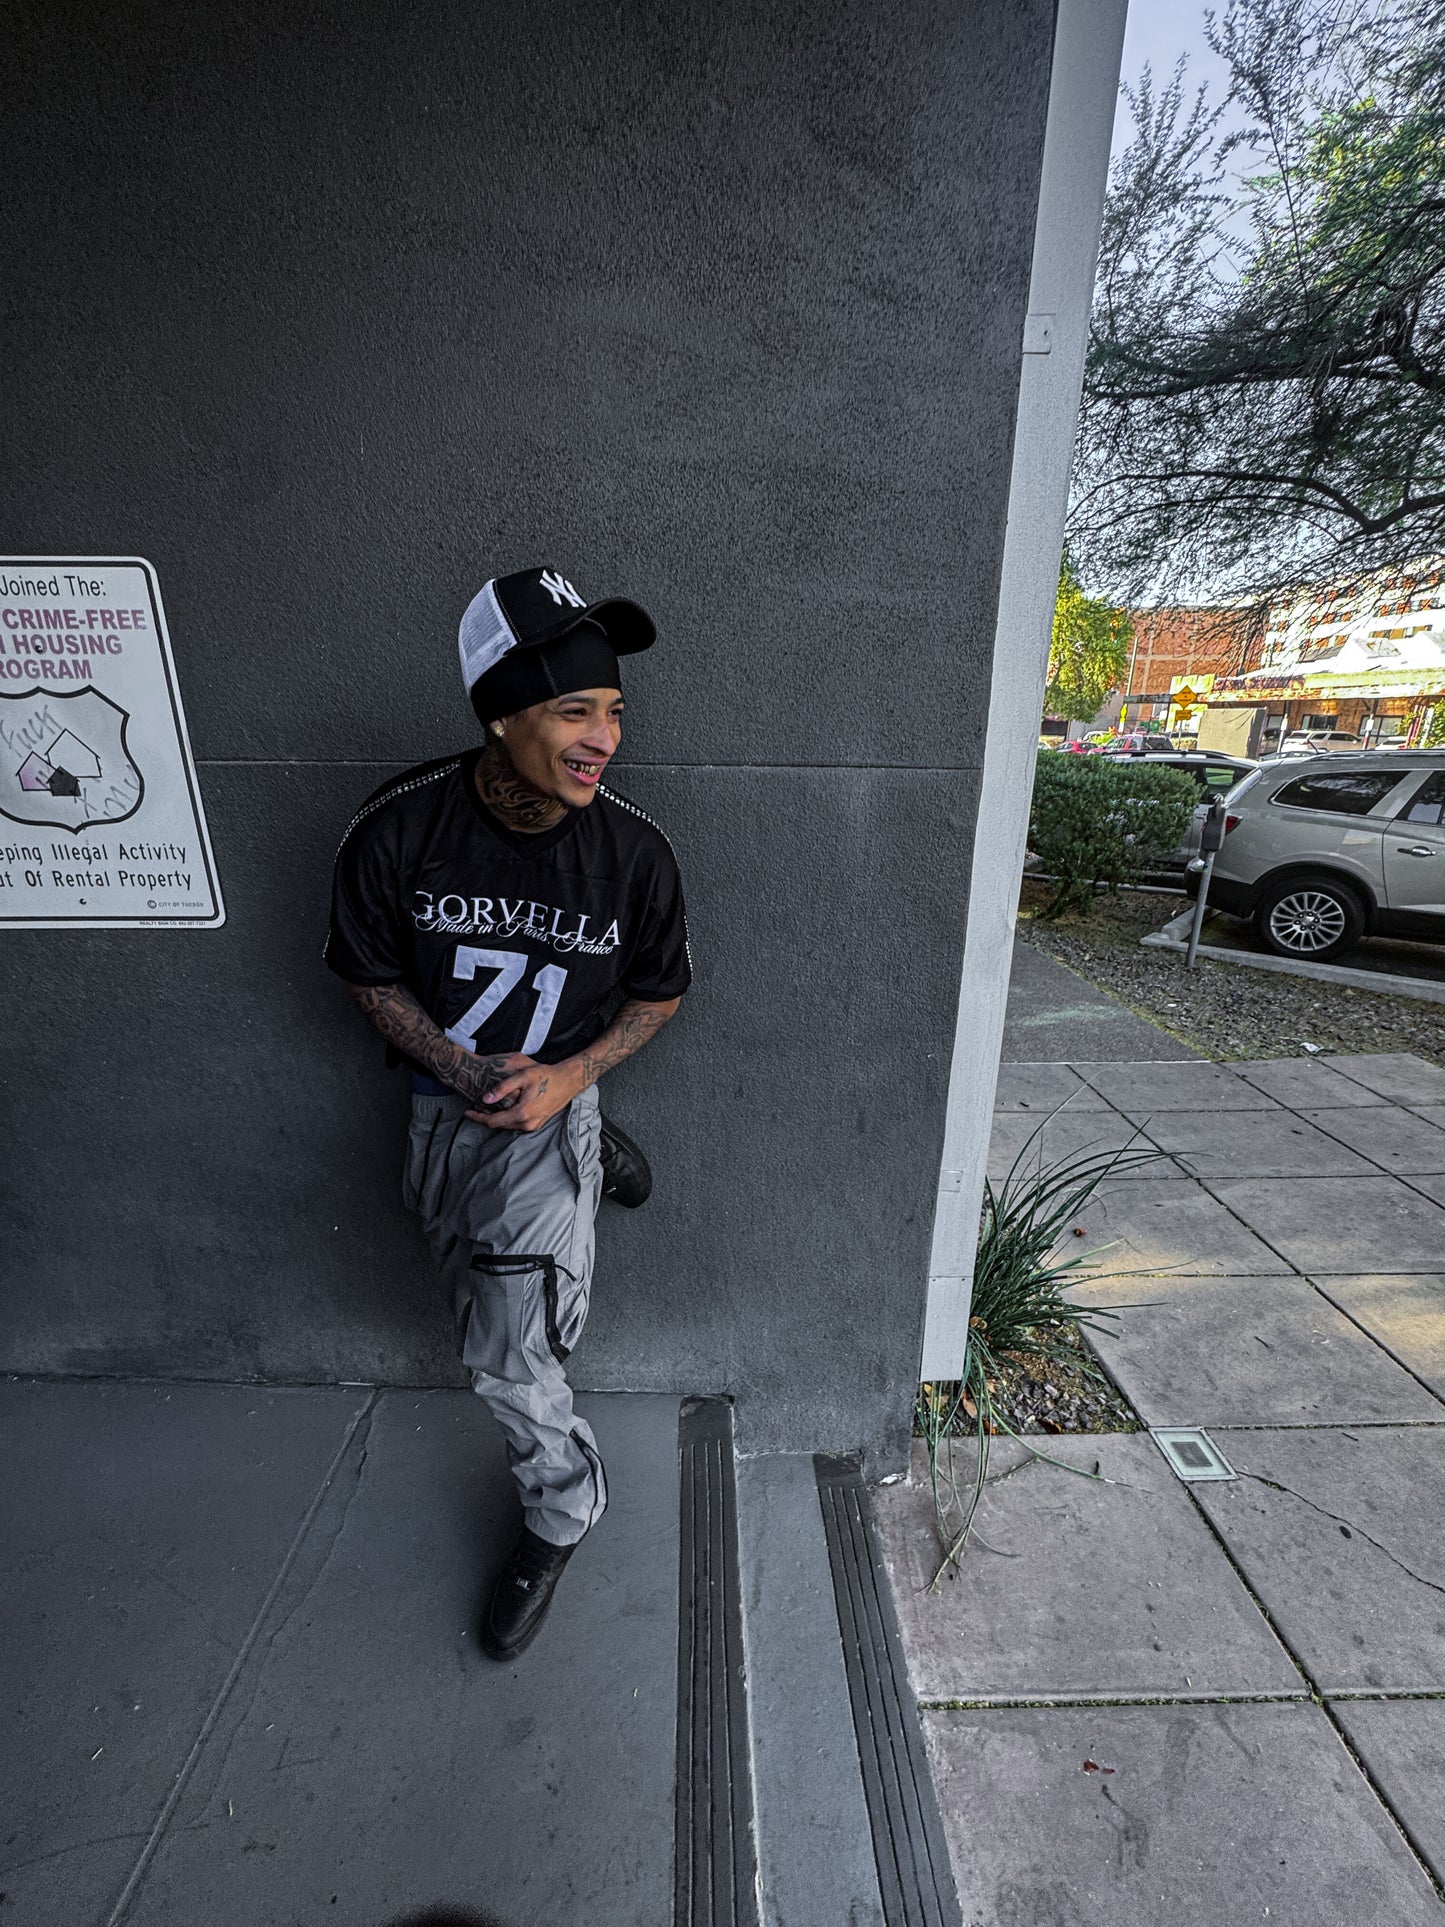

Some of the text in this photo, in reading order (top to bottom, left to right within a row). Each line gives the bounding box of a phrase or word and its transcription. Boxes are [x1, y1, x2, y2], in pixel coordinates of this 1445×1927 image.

[0, 574, 107, 597] Joined The:
[539, 569, 588, 609] NY
[2, 608, 147, 630] CRIME-FREE
[12, 633, 123, 655] HOUSING
[51, 843, 109, 866] Illegal
[119, 843, 187, 865] Activity
[25, 870, 43, 888] Of
[52, 870, 111, 888] Rental
[118, 870, 192, 891] Property
[411, 890, 622, 946] GORVELLA
[415, 914, 475, 935] Made
[477, 921, 494, 935] in
[553, 931, 614, 955] France
[444, 944, 569, 1056] 71
